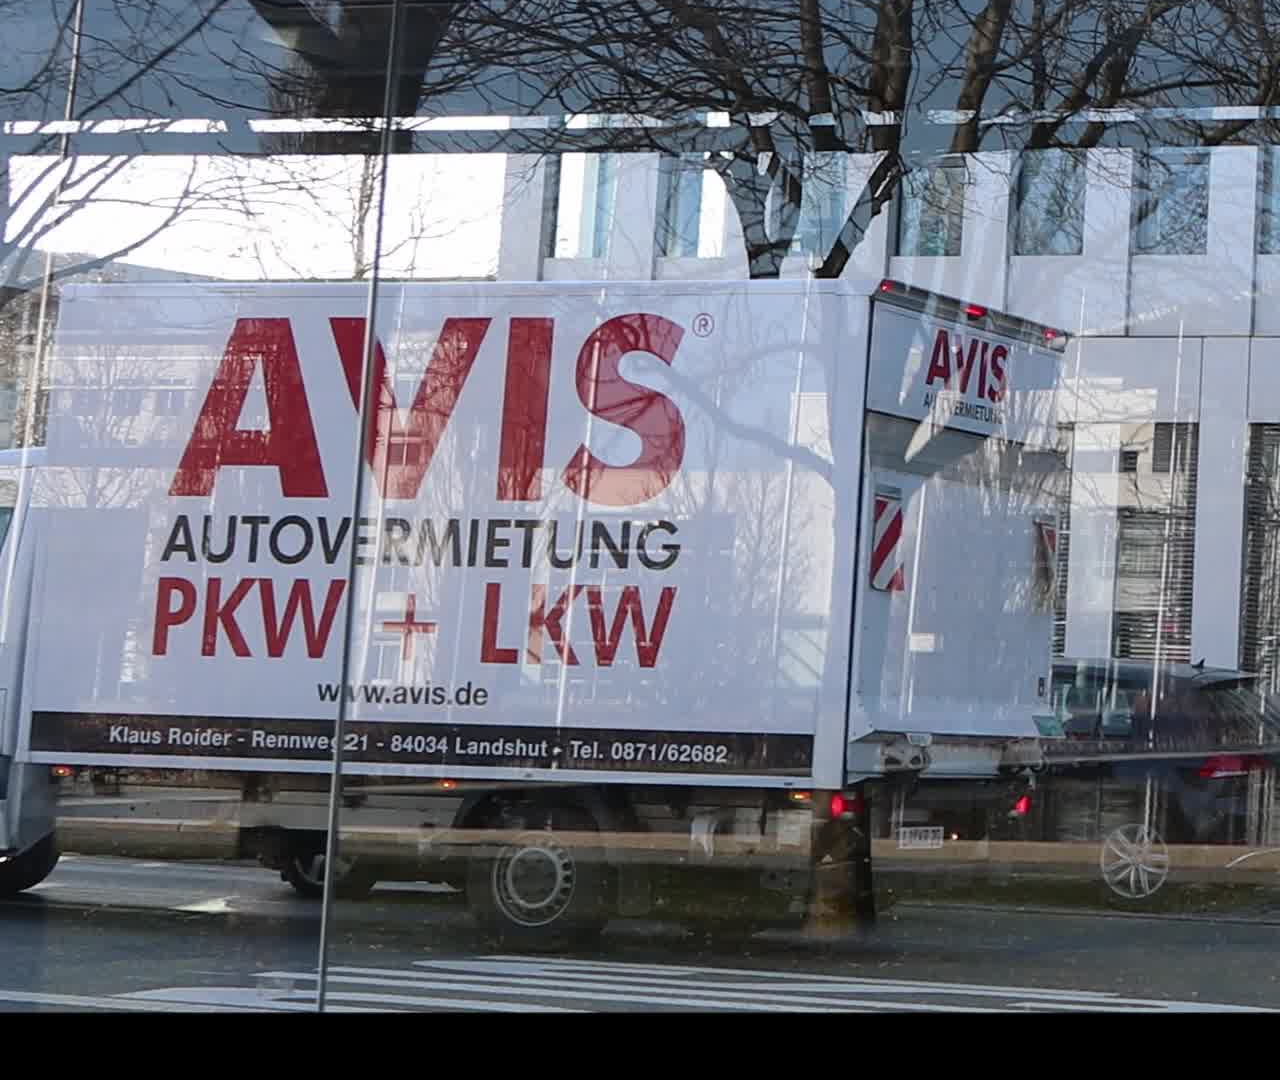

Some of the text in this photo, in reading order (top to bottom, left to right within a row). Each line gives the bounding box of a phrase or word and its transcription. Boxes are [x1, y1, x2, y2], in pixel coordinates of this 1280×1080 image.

[925, 328, 1008, 403] AVIS
[168, 312, 687, 506] AVIS
[160, 514, 681, 570] AUTOVERMIETUNG
[151, 576, 347, 659] PKW
[480, 582, 678, 667] LKW
[317, 681, 489, 706] www.avis.de
[109, 726, 161, 745] Klaus
[168, 727, 232, 747] Roider
[343, 733, 368, 752] 21
[391, 734, 449, 754] 84034
[455, 736, 548, 757] Landshut
[570, 740, 604, 759] Tel.
[611, 741, 728, 763] 0871/62682
